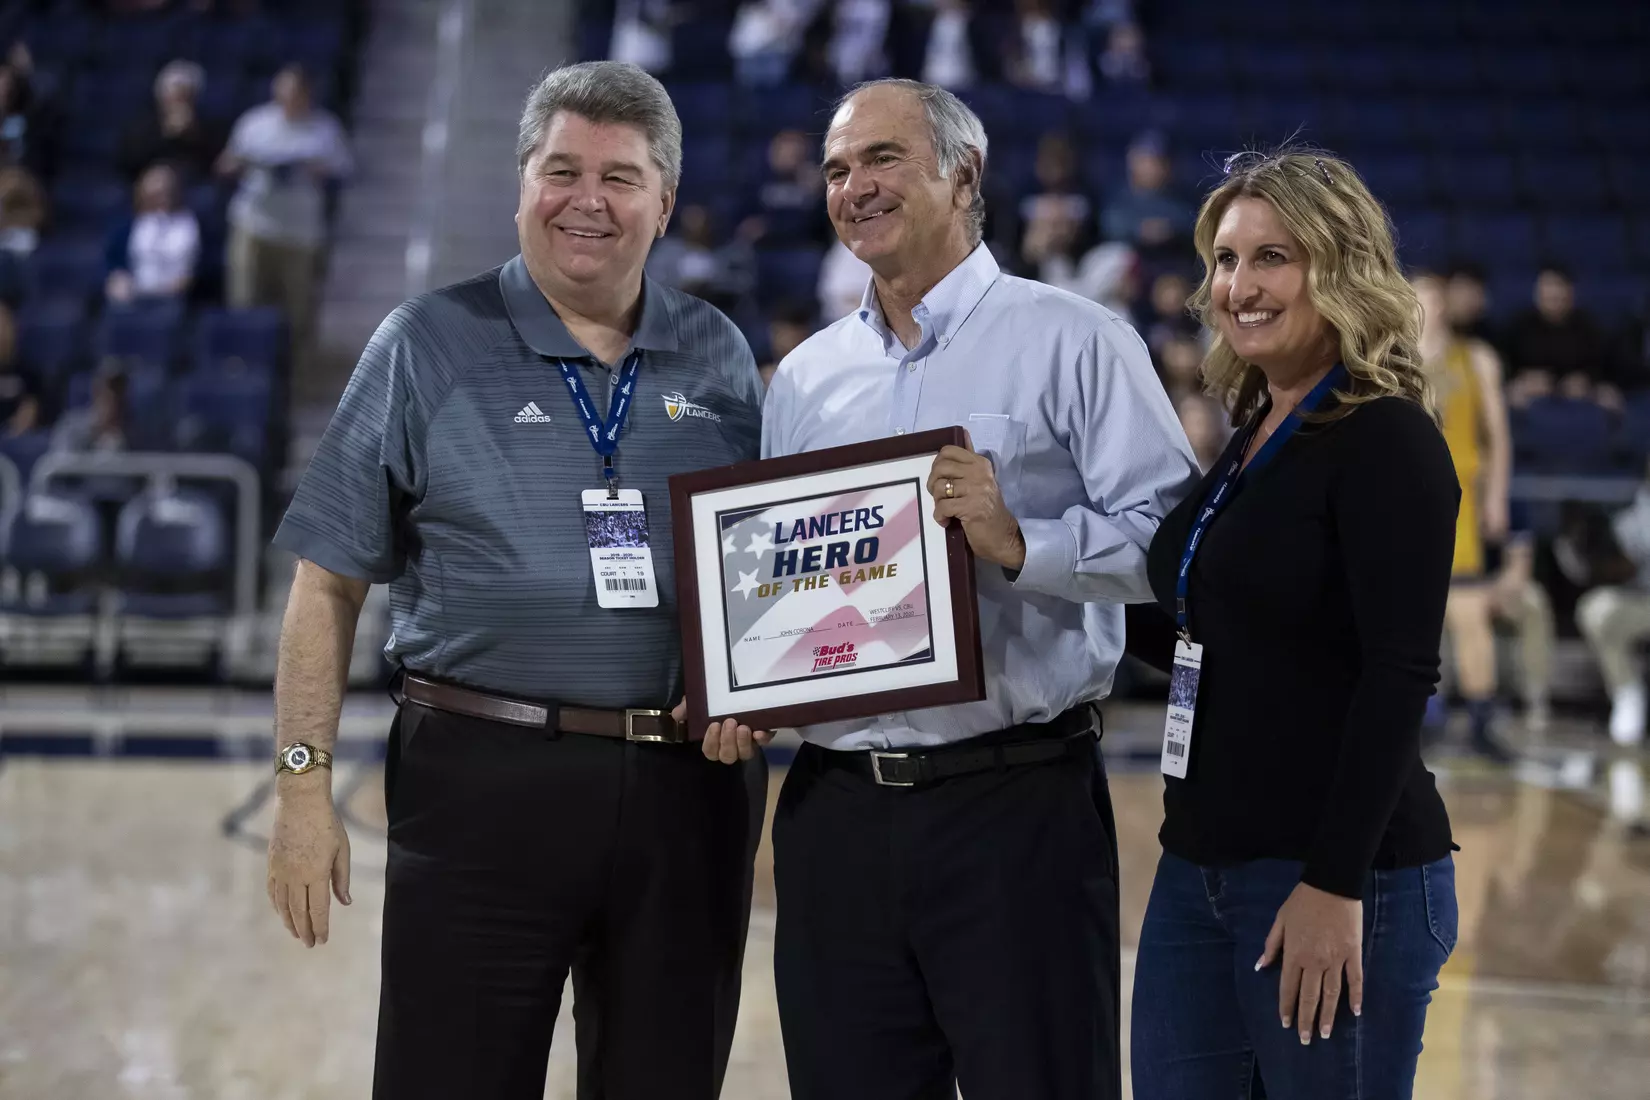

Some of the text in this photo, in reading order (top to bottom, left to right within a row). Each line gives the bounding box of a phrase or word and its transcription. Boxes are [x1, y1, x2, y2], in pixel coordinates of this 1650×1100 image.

[514, 414, 551, 423] adidas
[686, 408, 722, 422] LANCERS
[774, 504, 885, 545] LANCERS
[772, 536, 880, 578] HERO
[757, 563, 898, 598] OF THE GAME
[869, 614, 893, 623] FEBRUARY
[780, 629, 793, 637] JOHN
[792, 626, 814, 635] CORONA
[819, 642, 855, 657] Bud's
[813, 652, 858, 672] TIRE PROS
